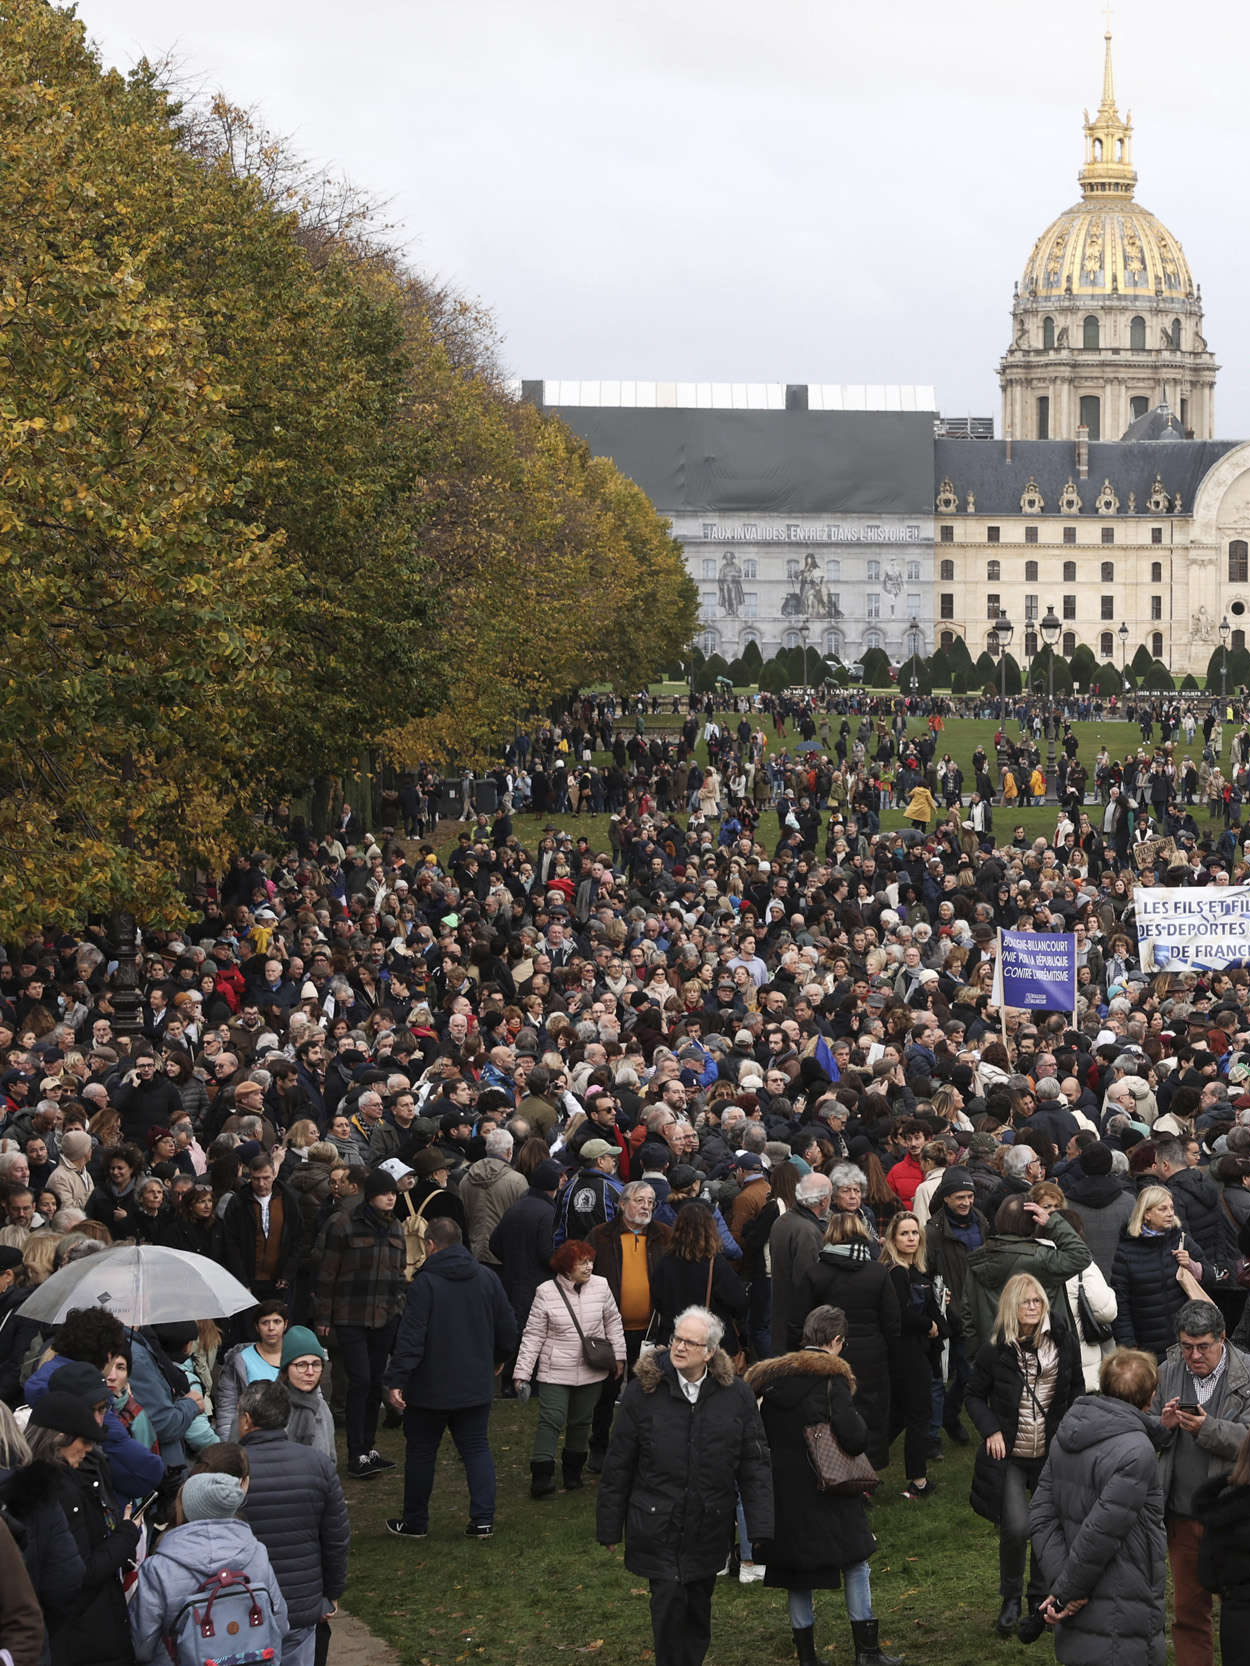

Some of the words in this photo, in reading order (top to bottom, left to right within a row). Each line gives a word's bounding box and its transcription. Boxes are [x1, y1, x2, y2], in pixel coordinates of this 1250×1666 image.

[711, 526, 731, 540] AUX
[734, 527, 788, 541] INVALIDES,
[790, 527, 829, 540] ENTREZ
[831, 527, 858, 541] DANS
[860, 528, 912, 541] L'HISTOIRE
[1143, 901, 1169, 915] LES
[1173, 900, 1204, 914] FILS
[1208, 900, 1227, 913] ET
[1138, 923, 1162, 937] DES
[1167, 922, 1246, 936] DEPORTES
[1170, 945, 1190, 959] DE
[1003, 966, 1032, 979] CONTRE
